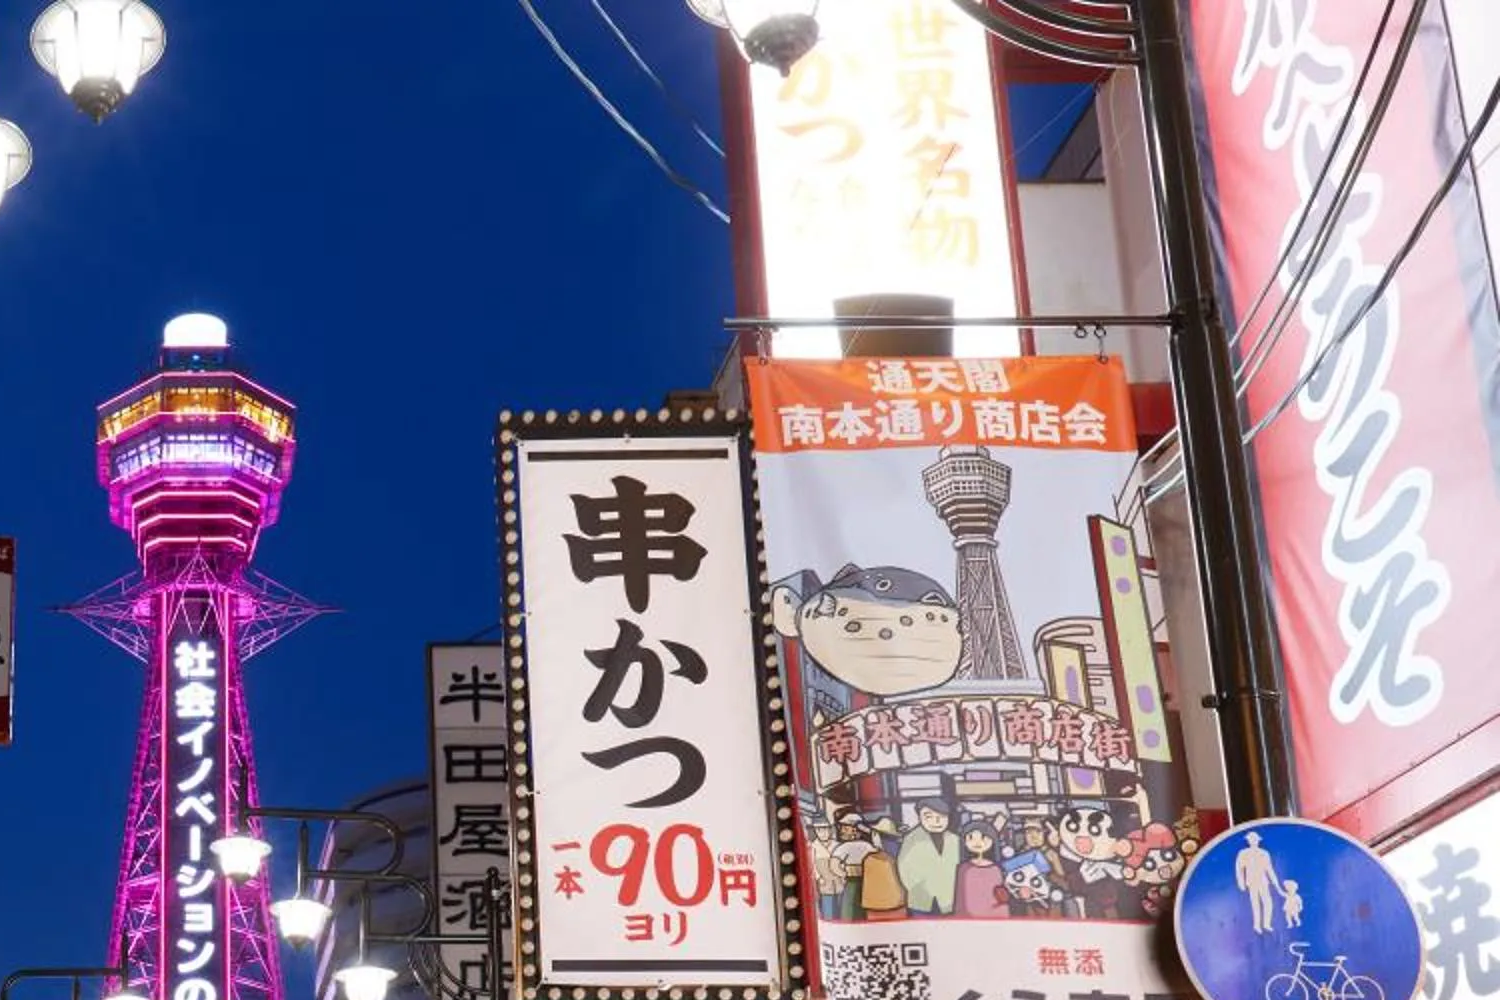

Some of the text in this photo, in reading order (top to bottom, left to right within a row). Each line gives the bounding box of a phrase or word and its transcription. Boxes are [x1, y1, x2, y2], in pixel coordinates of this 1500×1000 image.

[866, 360, 1011, 394] 通天閣
[778, 398, 1107, 445] 南本通り商店会
[561, 475, 708, 808] 串かつ
[818, 704, 1132, 765] 南本通り商店街
[551, 837, 585, 900] 一本
[589, 823, 758, 909] 90円
[624, 912, 688, 945] ヨリ
[1037, 947, 1106, 976] 無添
